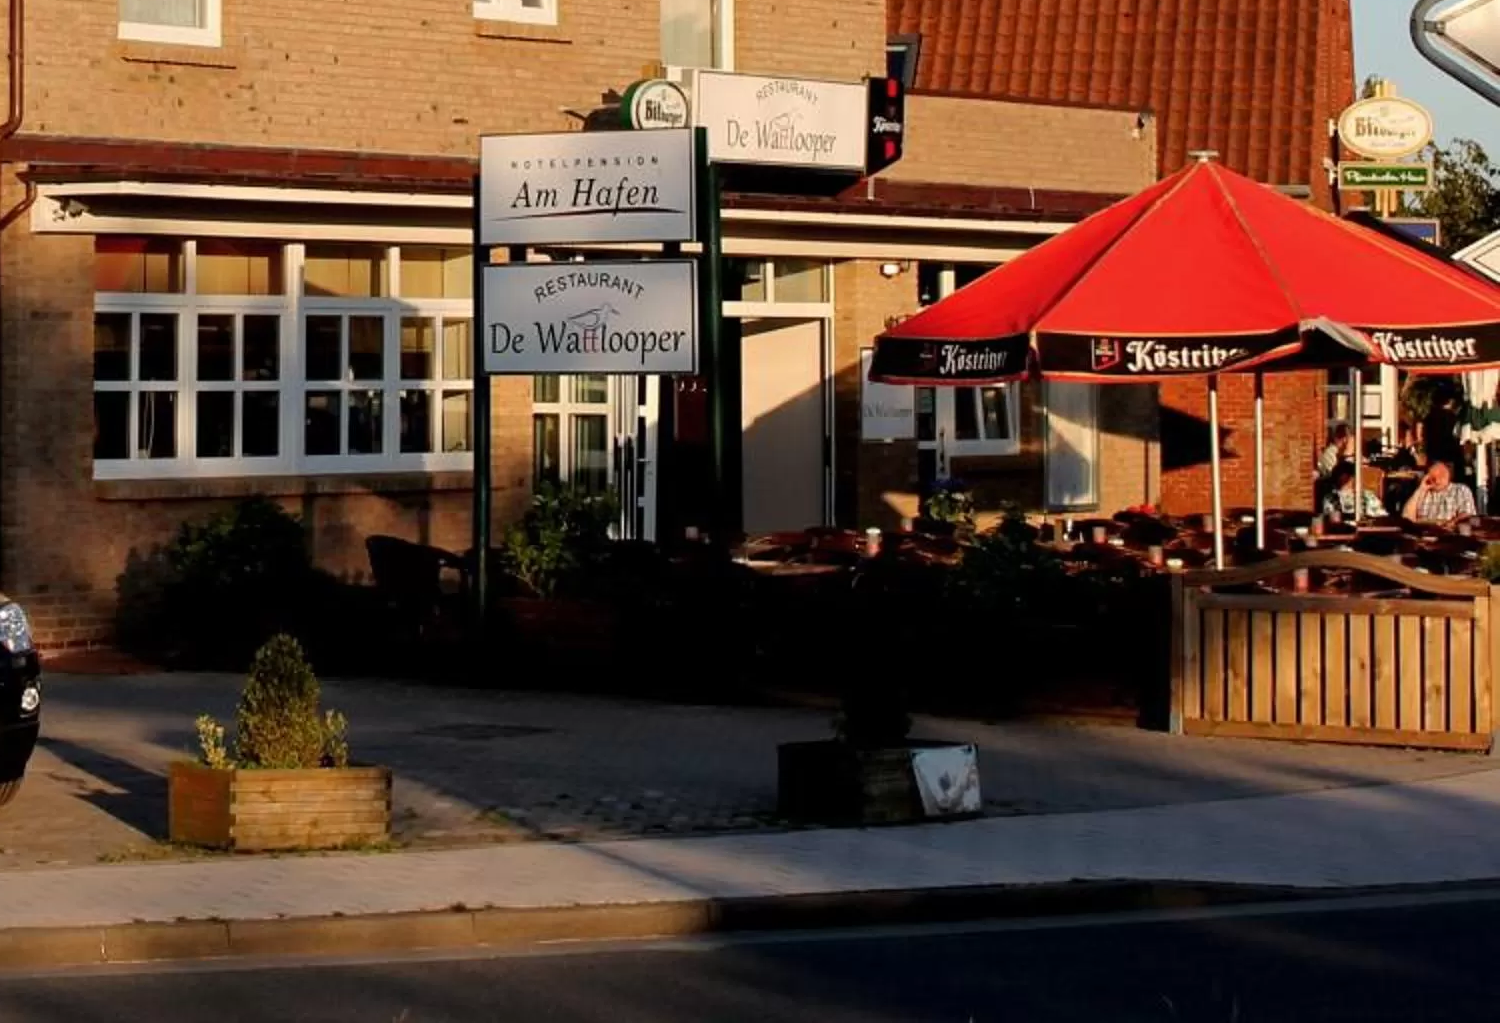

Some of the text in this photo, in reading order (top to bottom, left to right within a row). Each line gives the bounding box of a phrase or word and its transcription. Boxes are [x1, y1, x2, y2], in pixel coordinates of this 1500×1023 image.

[756, 80, 818, 105] RESTAURANT
[726, 119, 749, 148] De
[510, 155, 659, 170] HOTELPENSION
[510, 176, 660, 217] Am Hafen
[534, 272, 645, 304] RESTAURANT
[489, 322, 525, 354] De
[1371, 331, 1477, 363] Köstritzer
